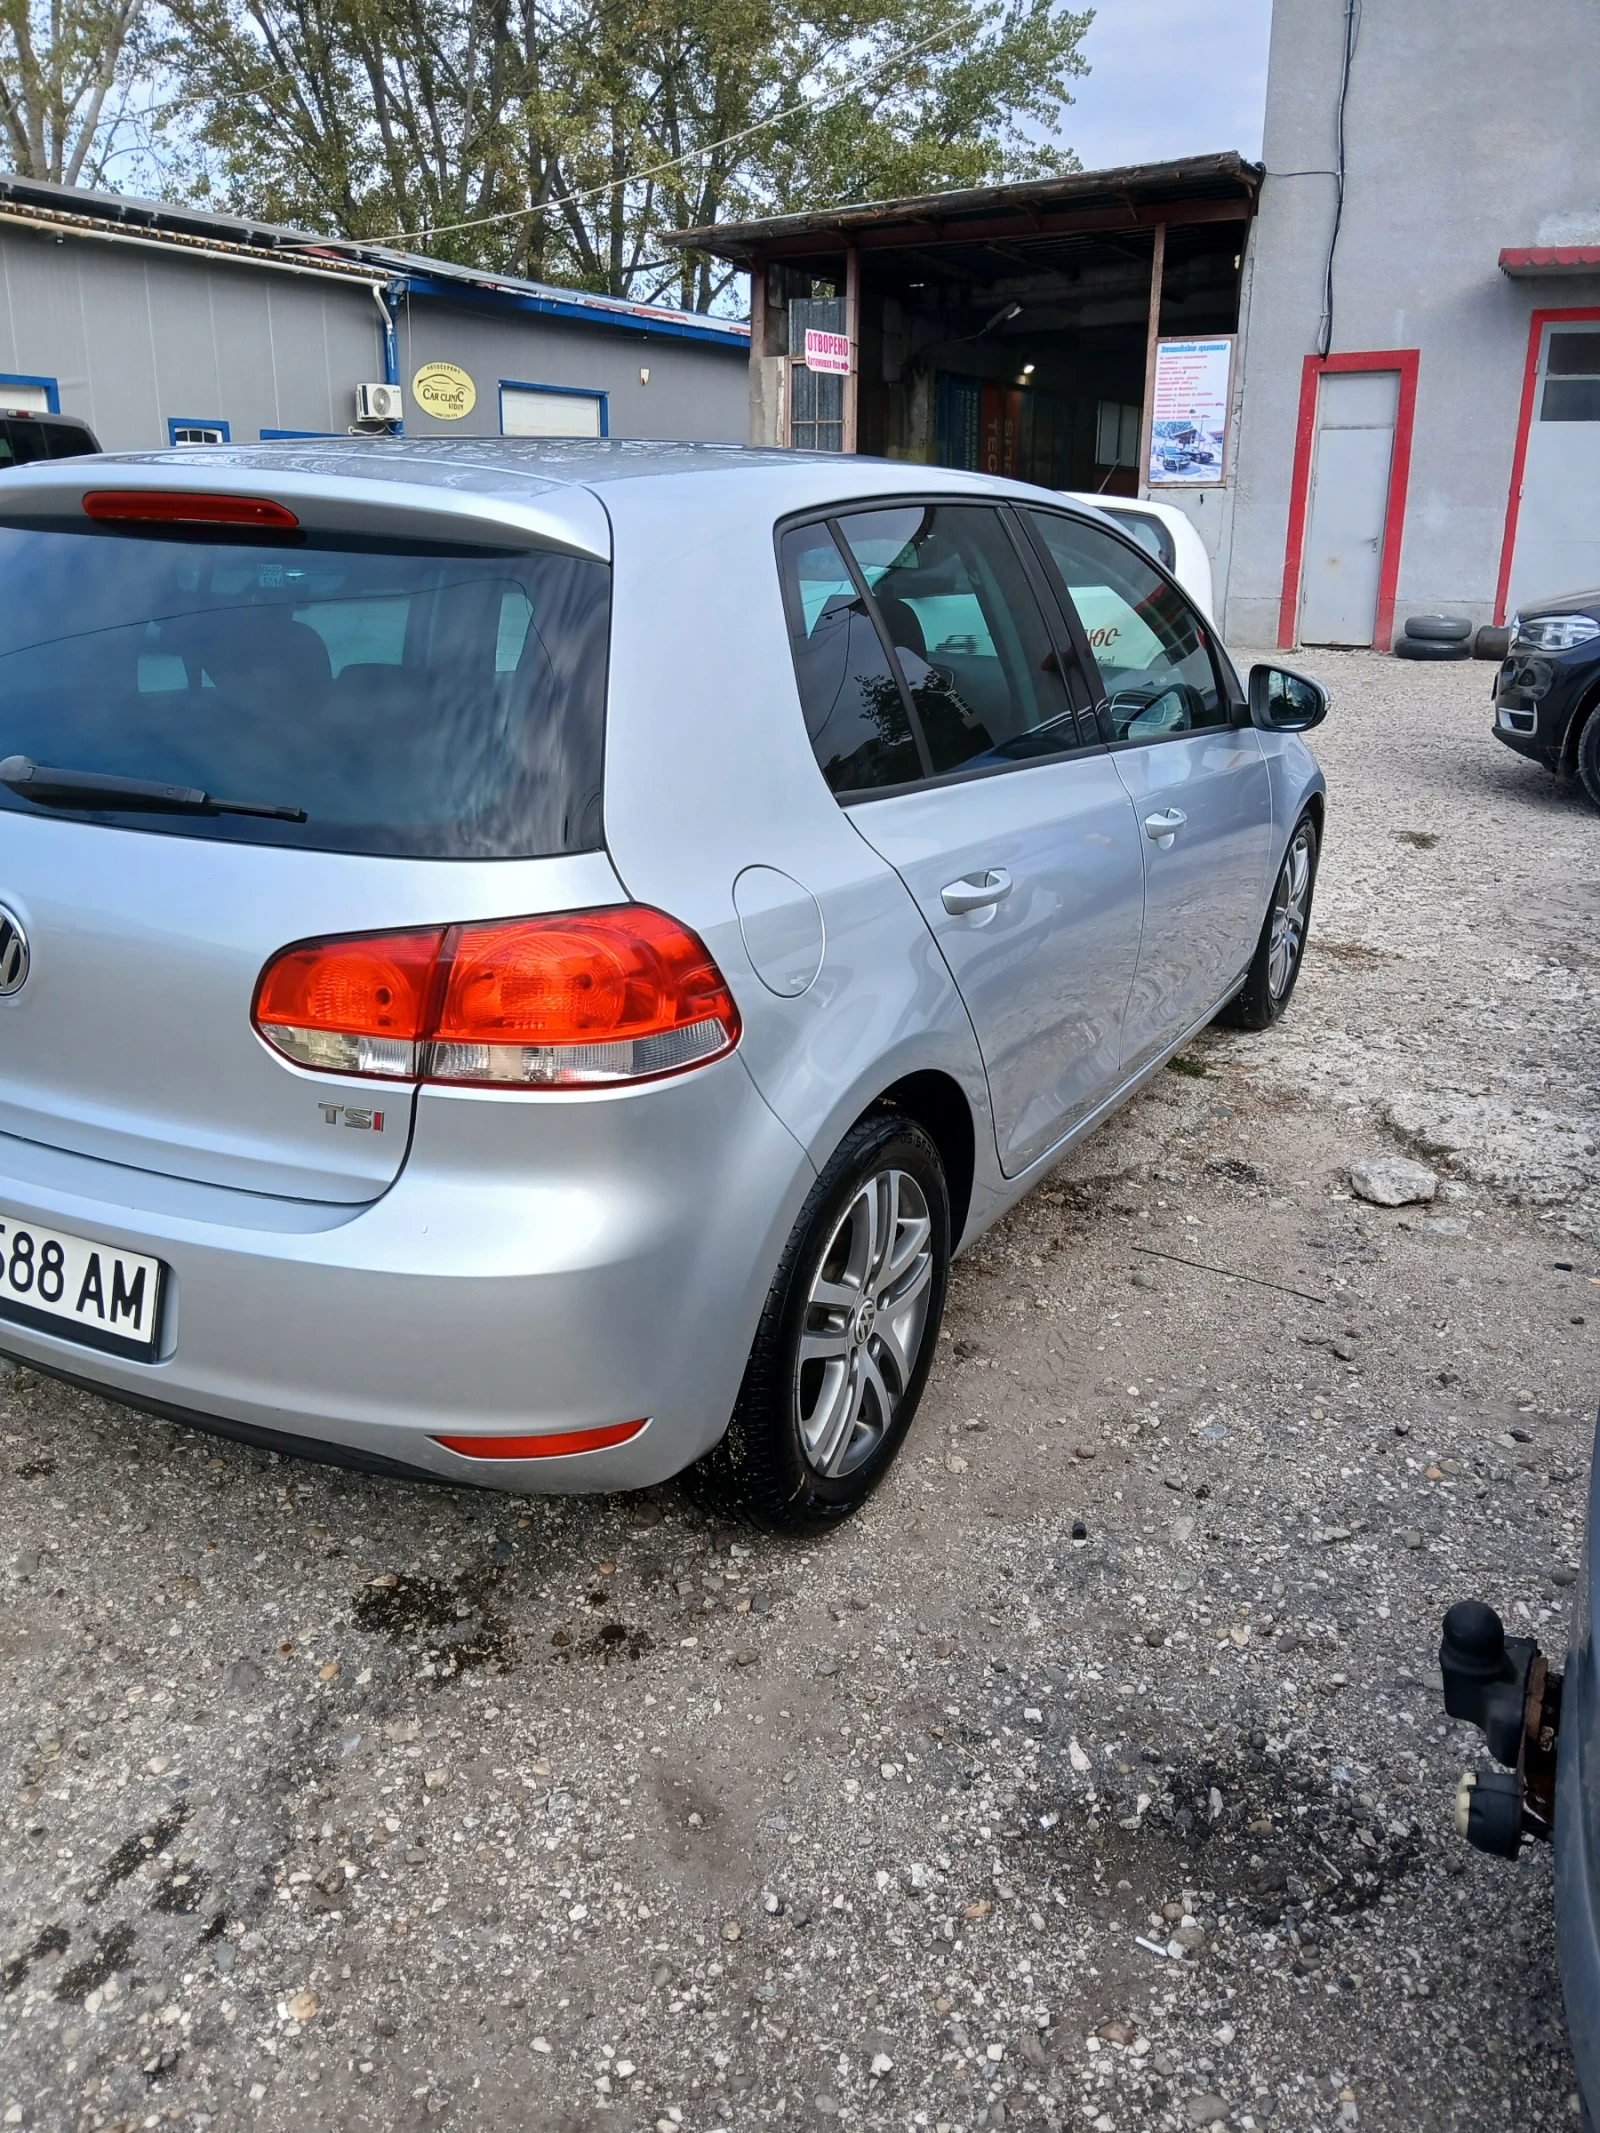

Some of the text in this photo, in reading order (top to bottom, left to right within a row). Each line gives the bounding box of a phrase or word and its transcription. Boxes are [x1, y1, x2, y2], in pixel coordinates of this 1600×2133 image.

[807, 331, 849, 357] ОТВОРЕНО
[448, 403, 464, 411] VIDIN
[318, 1100, 385, 1132] TSI
[75, 1252, 147, 1331] AM
